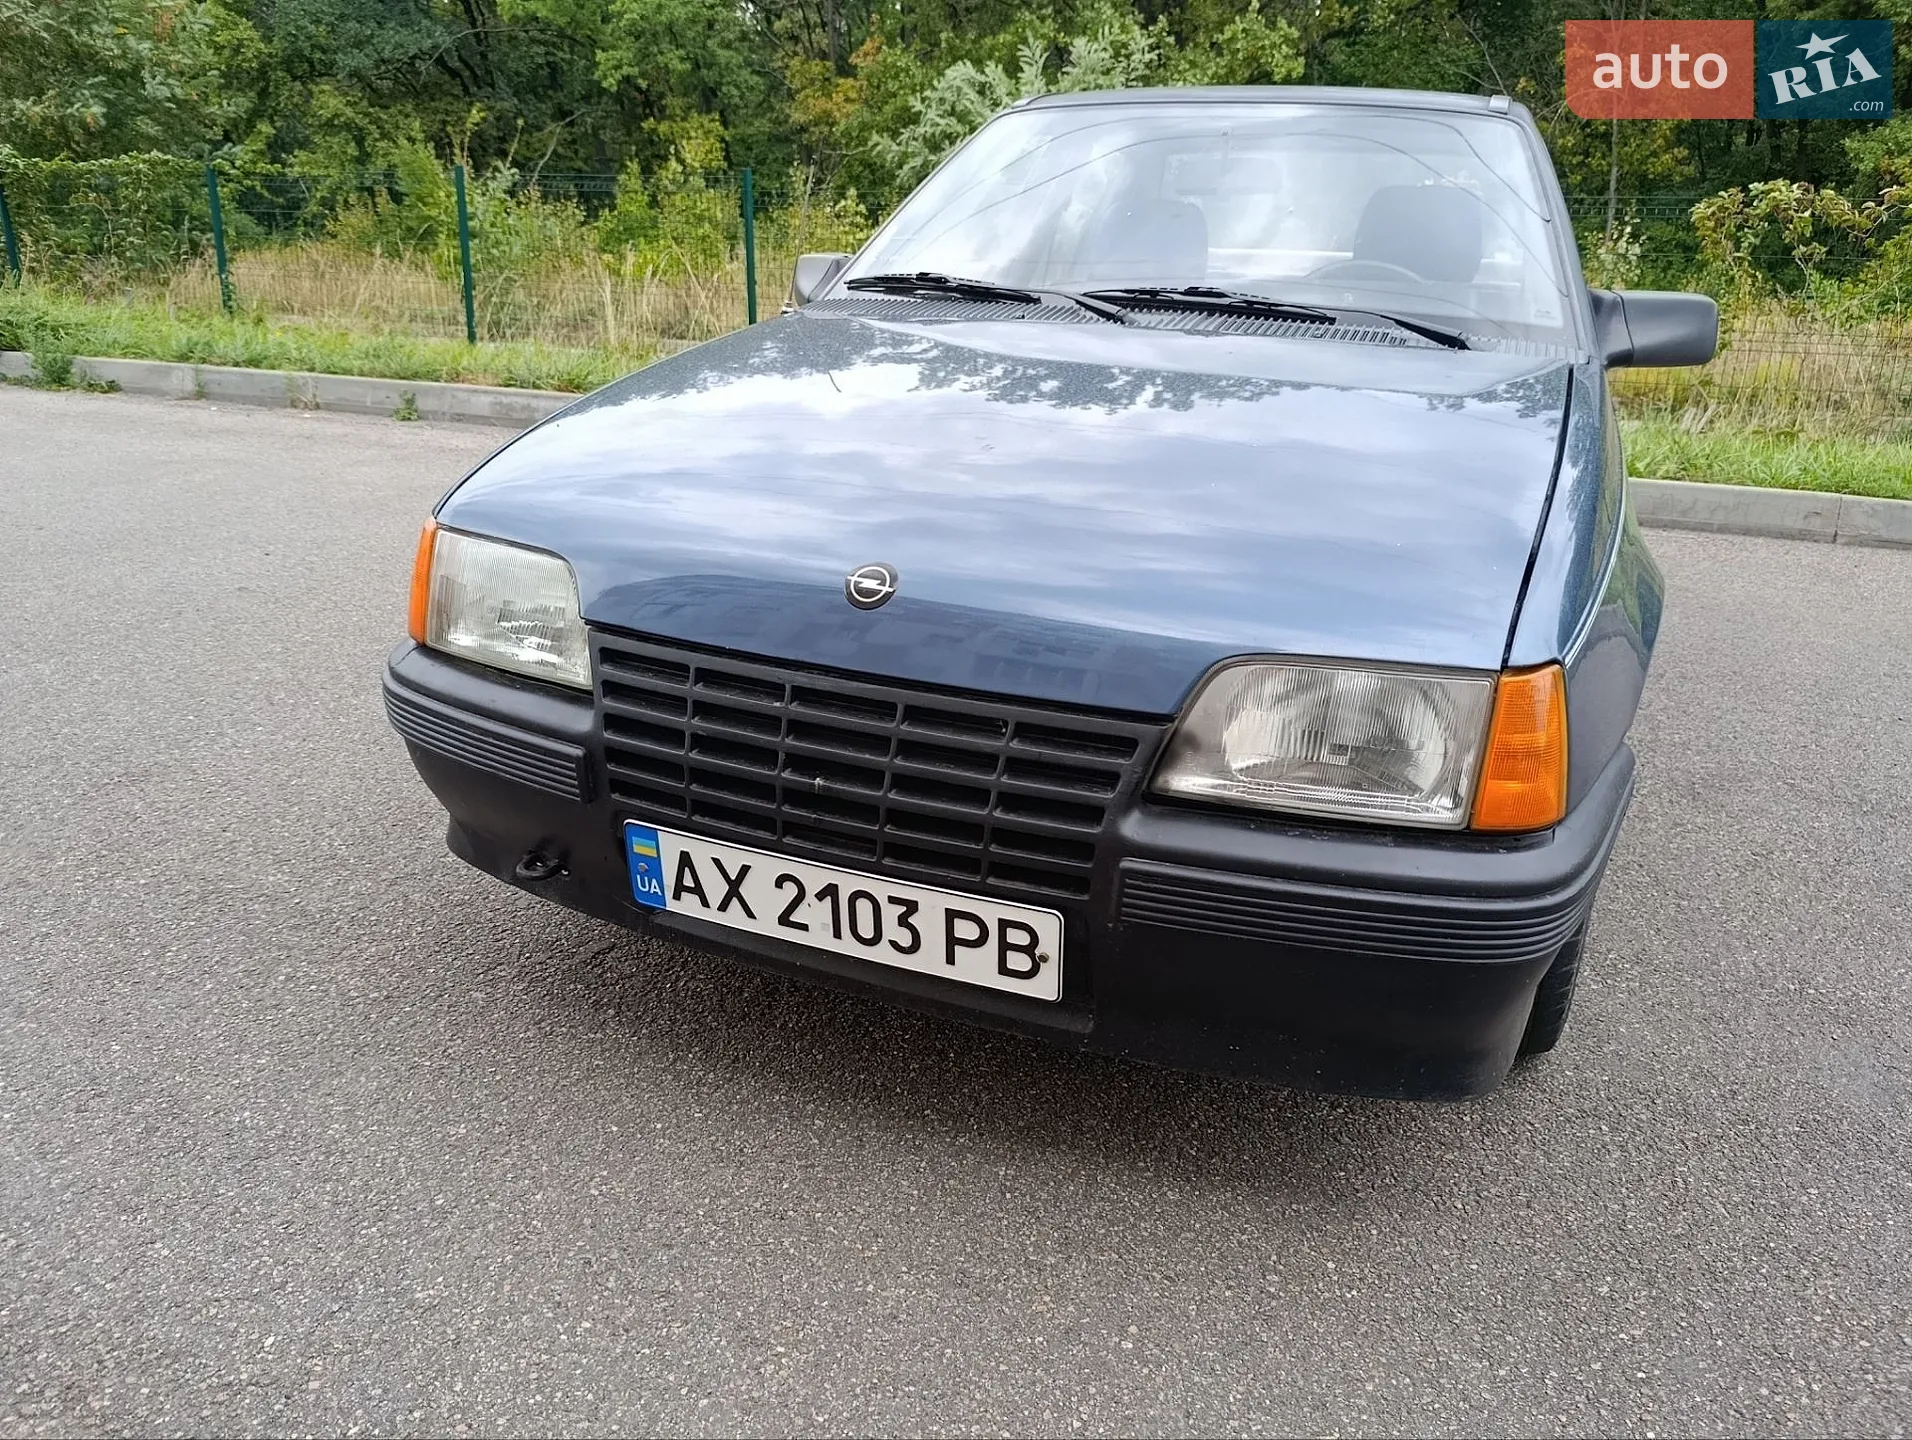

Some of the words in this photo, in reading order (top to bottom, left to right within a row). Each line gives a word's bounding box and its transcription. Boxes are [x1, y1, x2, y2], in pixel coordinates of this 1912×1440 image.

[636, 877, 662, 896] UA
[672, 850, 757, 920] AX
[774, 873, 922, 955] 2103
[944, 907, 1041, 981] PB
